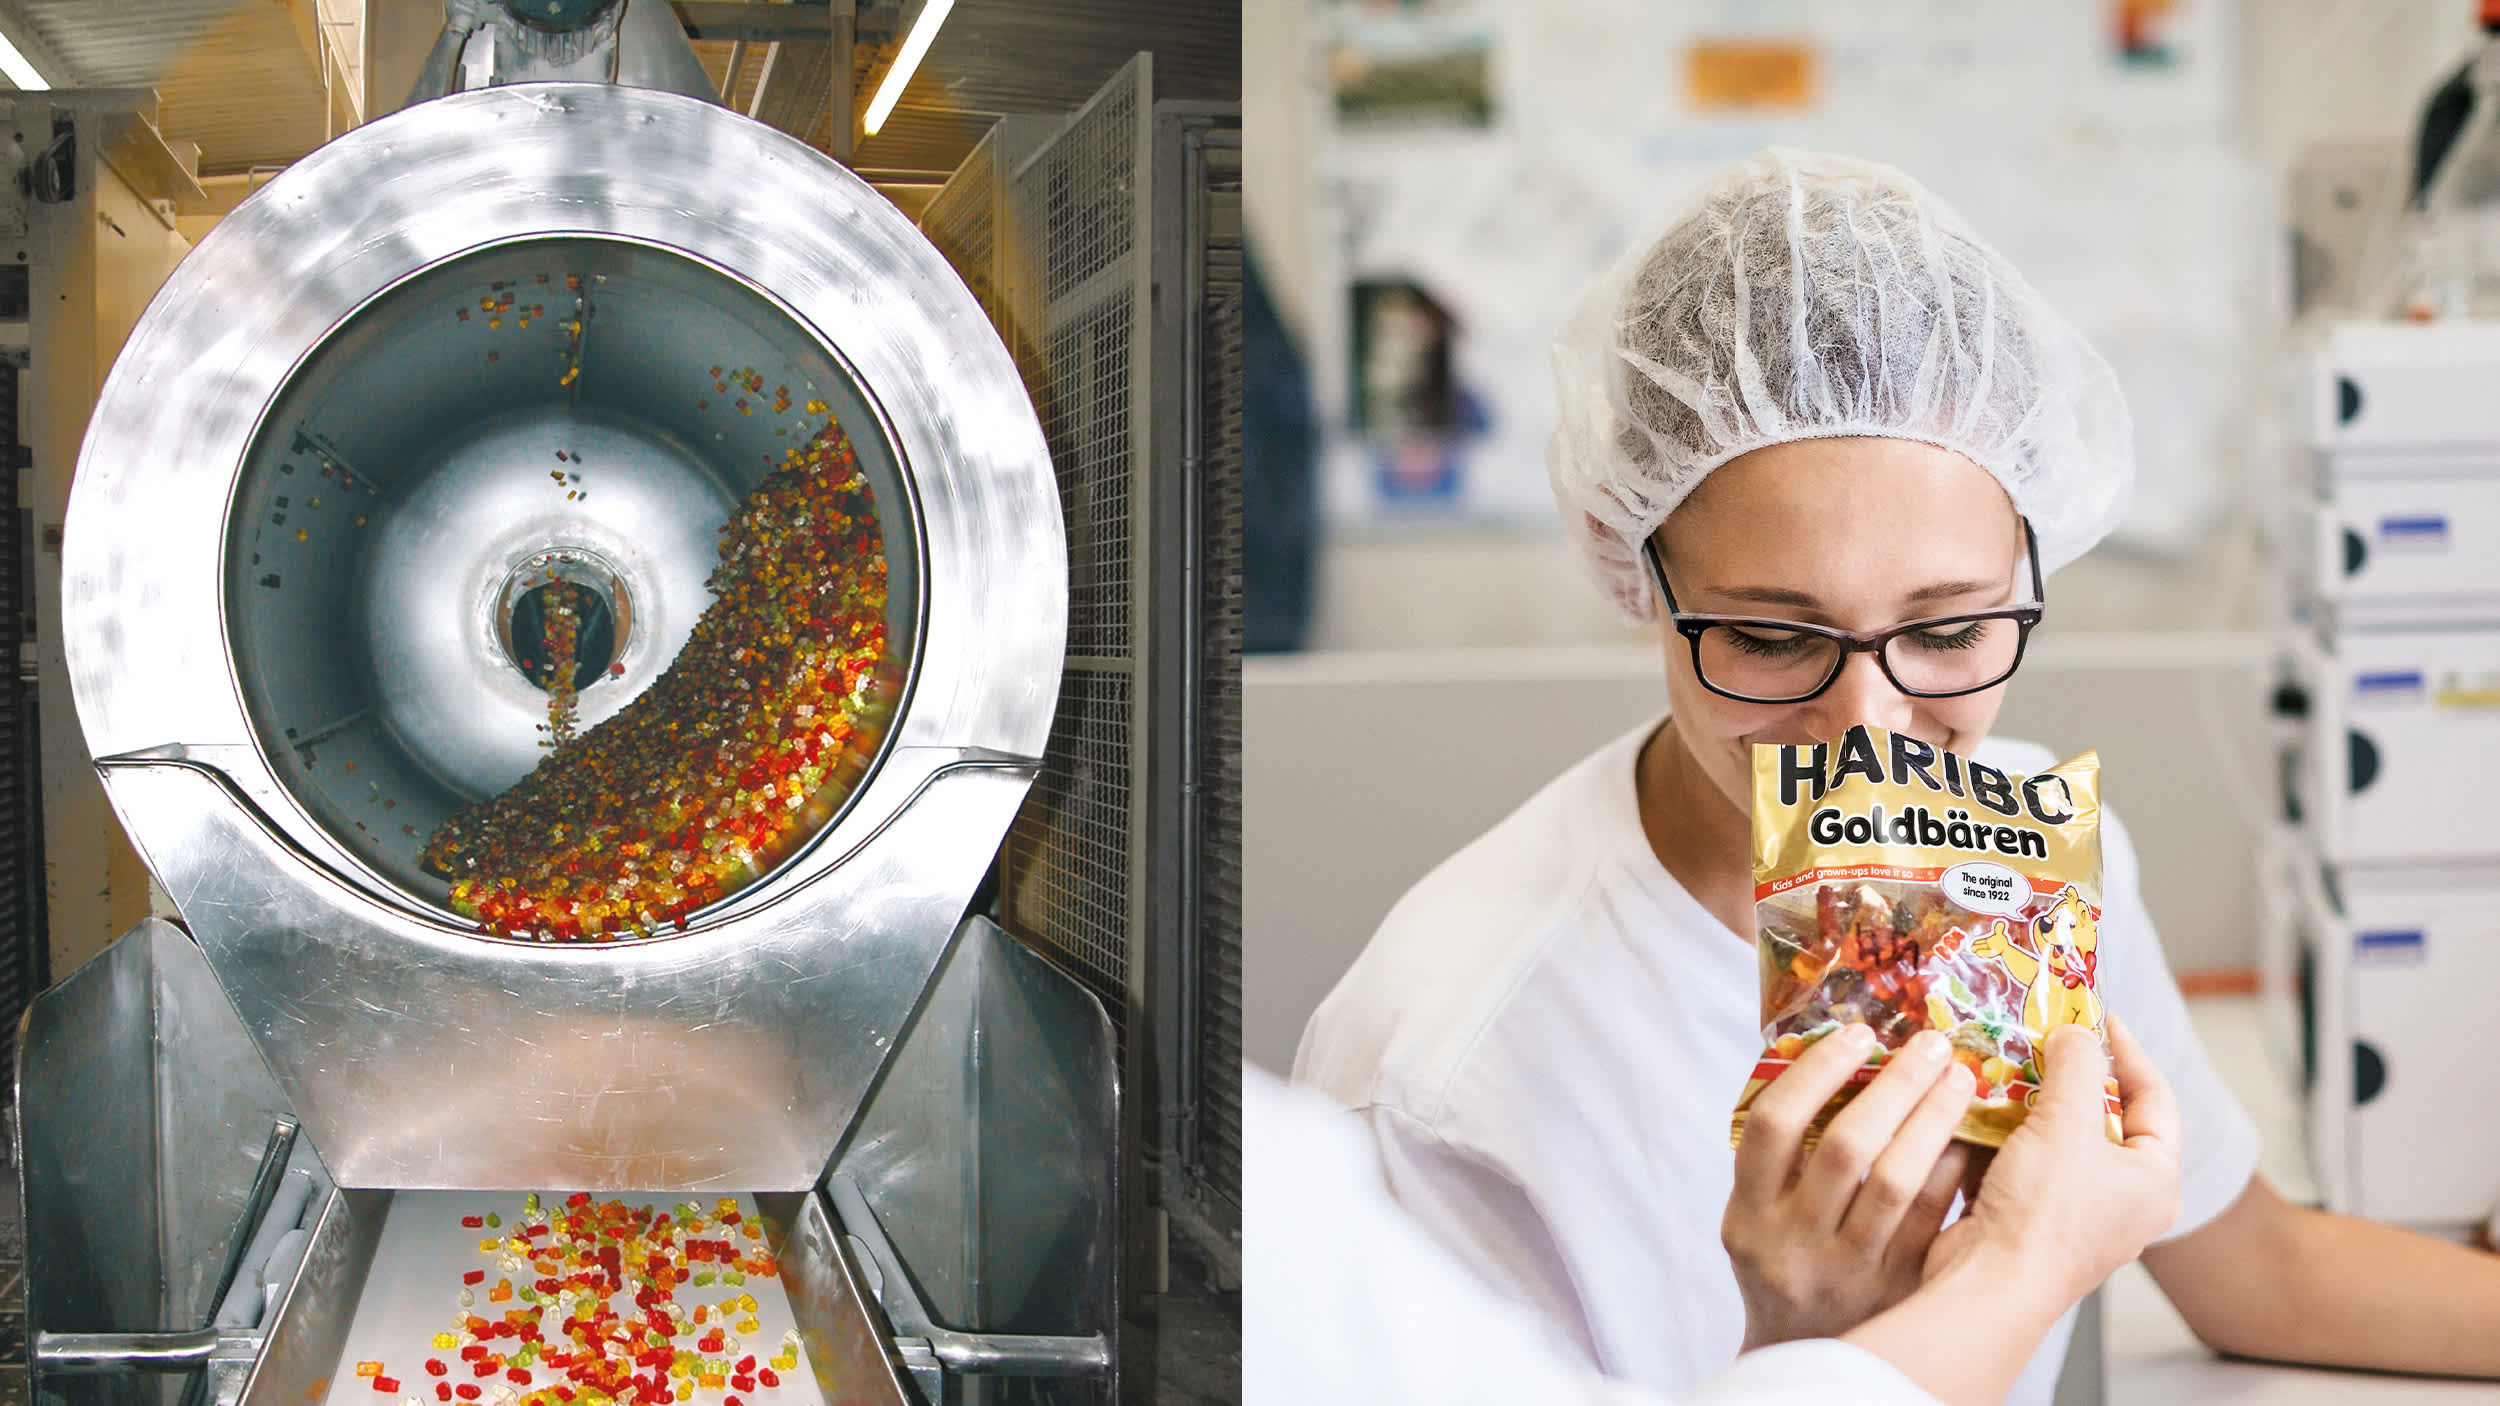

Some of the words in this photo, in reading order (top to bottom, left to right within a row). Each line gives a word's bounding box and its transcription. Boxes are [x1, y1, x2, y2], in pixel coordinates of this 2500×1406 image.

[1779, 724, 2074, 825] HARIBO
[1811, 807, 2047, 858] Goldbären
[1772, 878, 1793, 892] Kids
[1795, 869, 1814, 883] and
[1816, 868, 1869, 879] grown-ups
[1871, 867, 1890, 876] love
[1893, 867, 1900, 877] it
[1962, 872, 1976, 883] The
[1979, 876, 2012, 888] original
[1963, 887, 1986, 898] since
[1988, 891, 2009, 901] 1922
